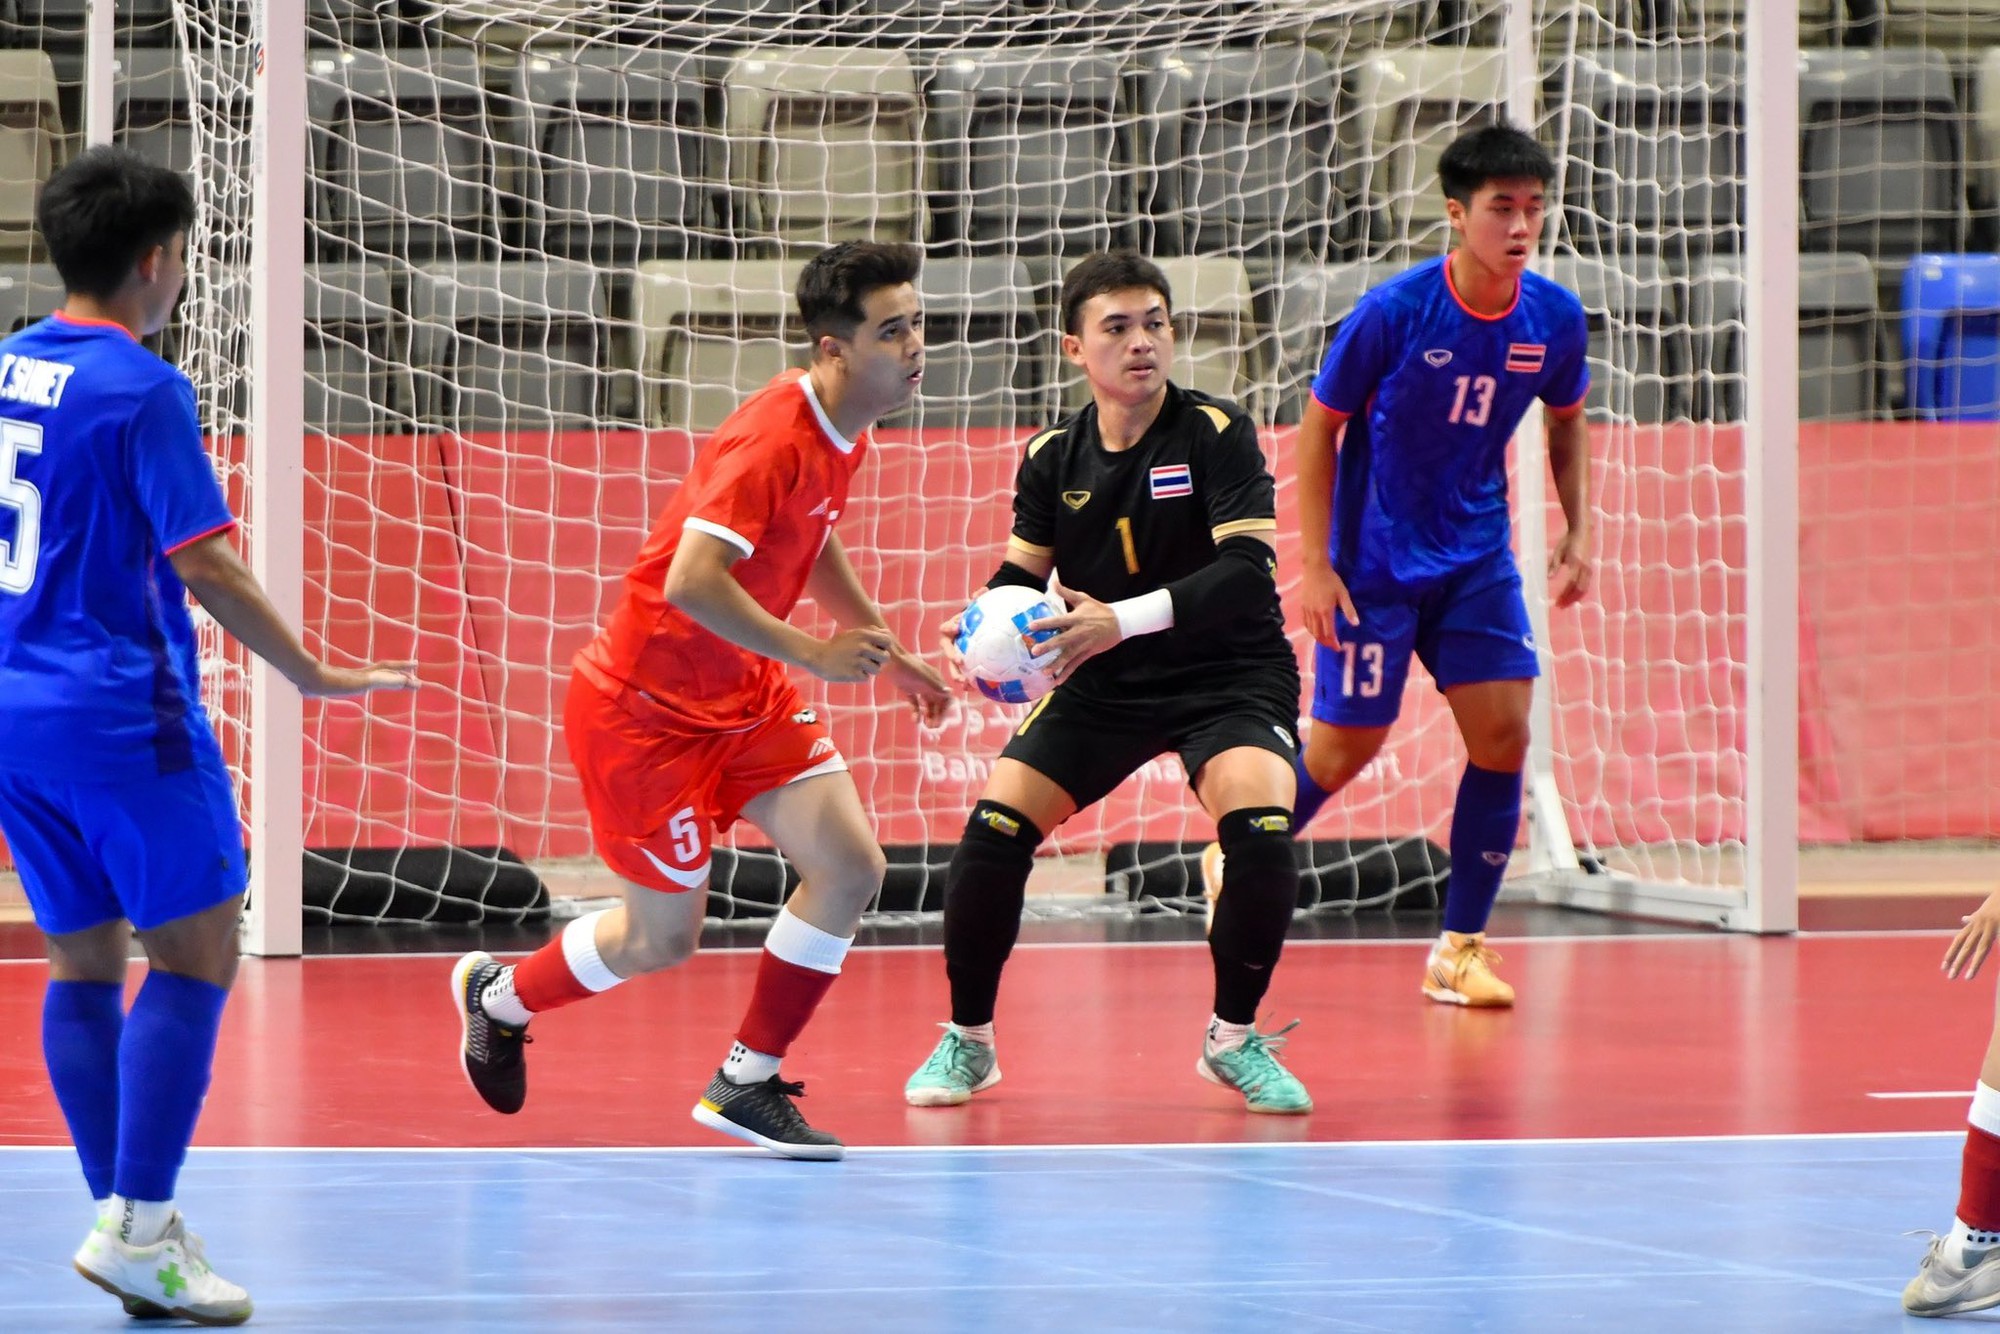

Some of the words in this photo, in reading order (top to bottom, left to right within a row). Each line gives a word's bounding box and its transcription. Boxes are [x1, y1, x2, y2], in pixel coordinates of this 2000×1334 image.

[1448, 374, 1497, 427] 13
[1115, 517, 1140, 575] 1
[1342, 640, 1384, 698] 13
[668, 806, 702, 863] 5
